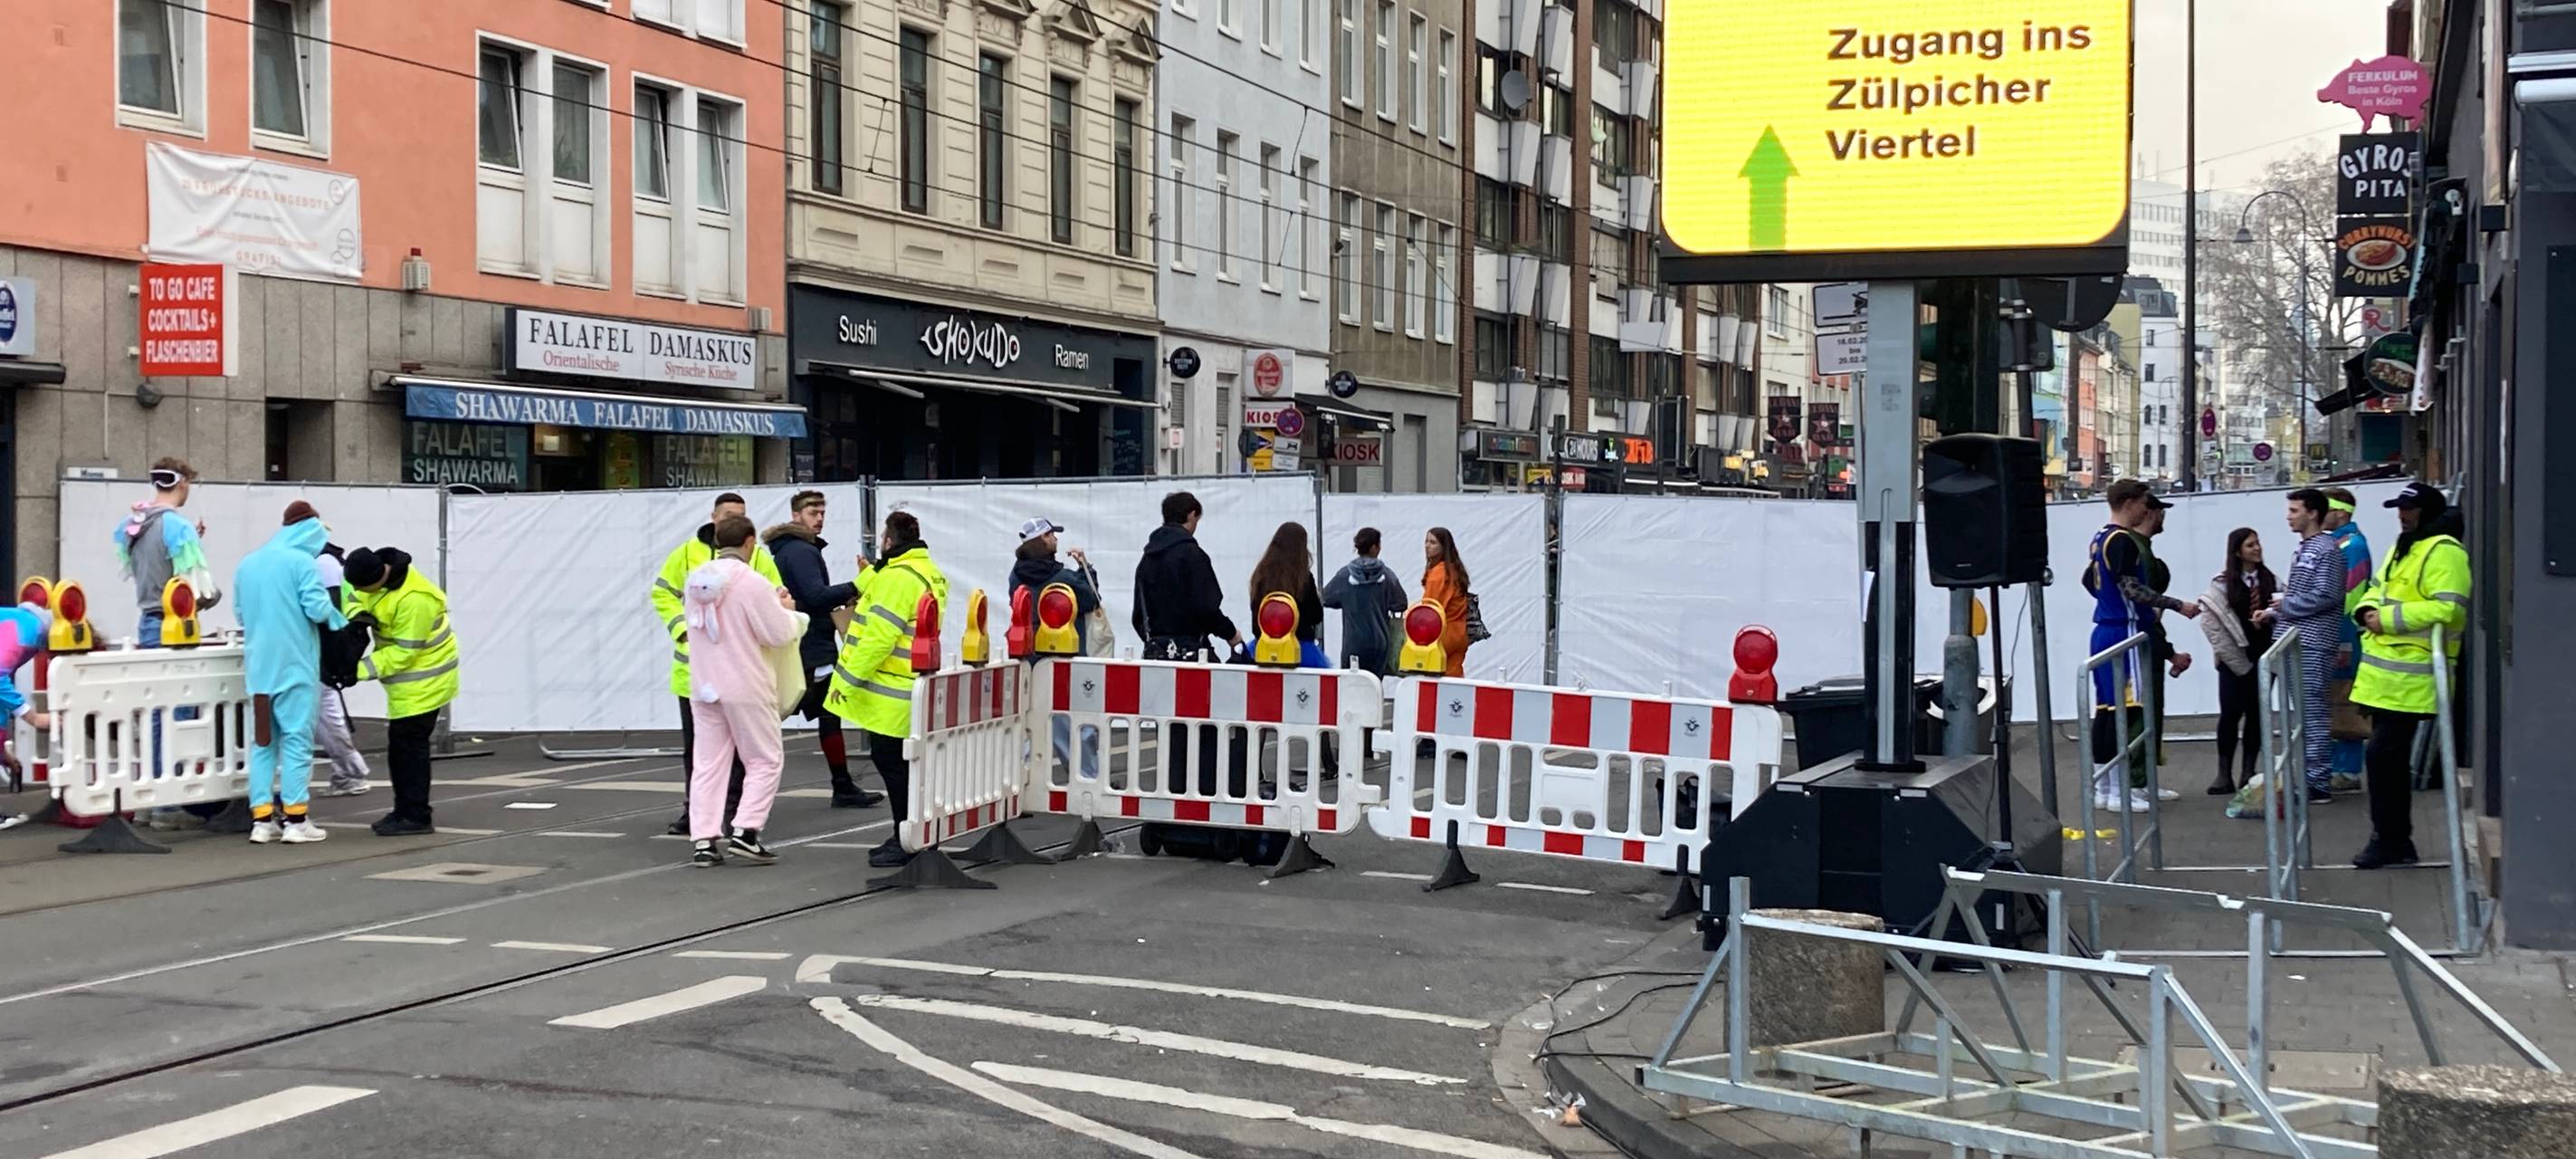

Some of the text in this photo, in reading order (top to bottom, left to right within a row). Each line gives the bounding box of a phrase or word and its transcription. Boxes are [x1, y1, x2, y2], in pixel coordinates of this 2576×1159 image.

[1827, 20, 2093, 64] Zugang ins
[1826, 73, 2051, 115] Zülpicher
[2347, 85, 2418, 96] Beste Gyros
[2361, 96, 2403, 106] in Köln
[1825, 125, 1976, 161] Viertel
[2355, 179, 2407, 197] PITA
[148, 277, 216, 301] TO GO CAFE
[2342, 264, 2410, 286] POMMES
[529, 318, 752, 365] FALAFEL DAMASKUS
[838, 315, 877, 345] Sushi
[920, 314, 1021, 369] SHOKUDO
[145, 340, 218, 363] FLASCHENBIER
[543, 350, 738, 380] Orientalische Syrische Küche
[1054, 343, 1090, 369] Ramen
[455, 391, 775, 435] SHAWARMA FALAFEL DAMASKUS
[412, 421, 520, 457] FALAFEL
[665, 435, 746, 466] FALAFEL
[413, 458, 520, 484] SHAWARMA
